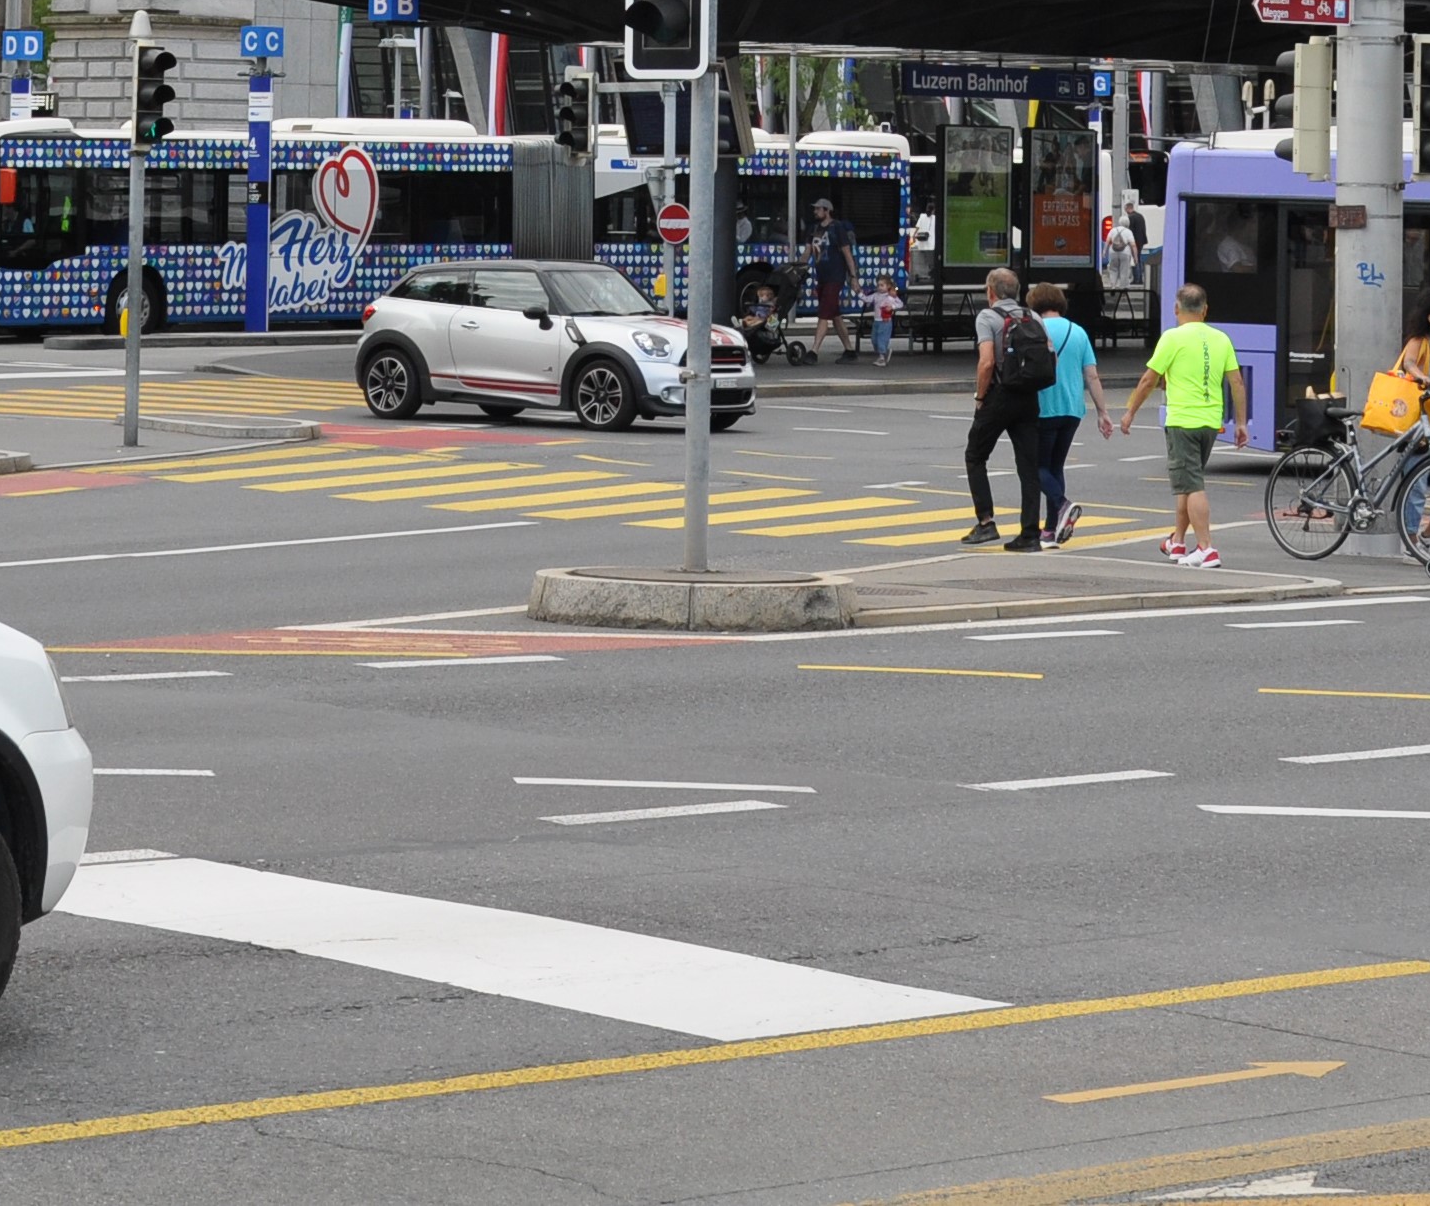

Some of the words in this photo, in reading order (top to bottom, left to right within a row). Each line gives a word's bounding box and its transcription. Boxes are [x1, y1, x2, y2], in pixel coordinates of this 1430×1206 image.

[1262, 7, 1289, 21] Meggen
[5, 35, 17, 55] D
[24, 35, 38, 55] D
[244, 31, 258, 52] C
[265, 31, 279, 52] C
[912, 70, 962, 90] Luzern
[967, 72, 1029, 93] Bahnhof
[1077, 82, 1085, 95] B
[1093, 76, 1106, 91] G
[249, 137, 256, 150] 4
[270, 218, 352, 284] Herz
